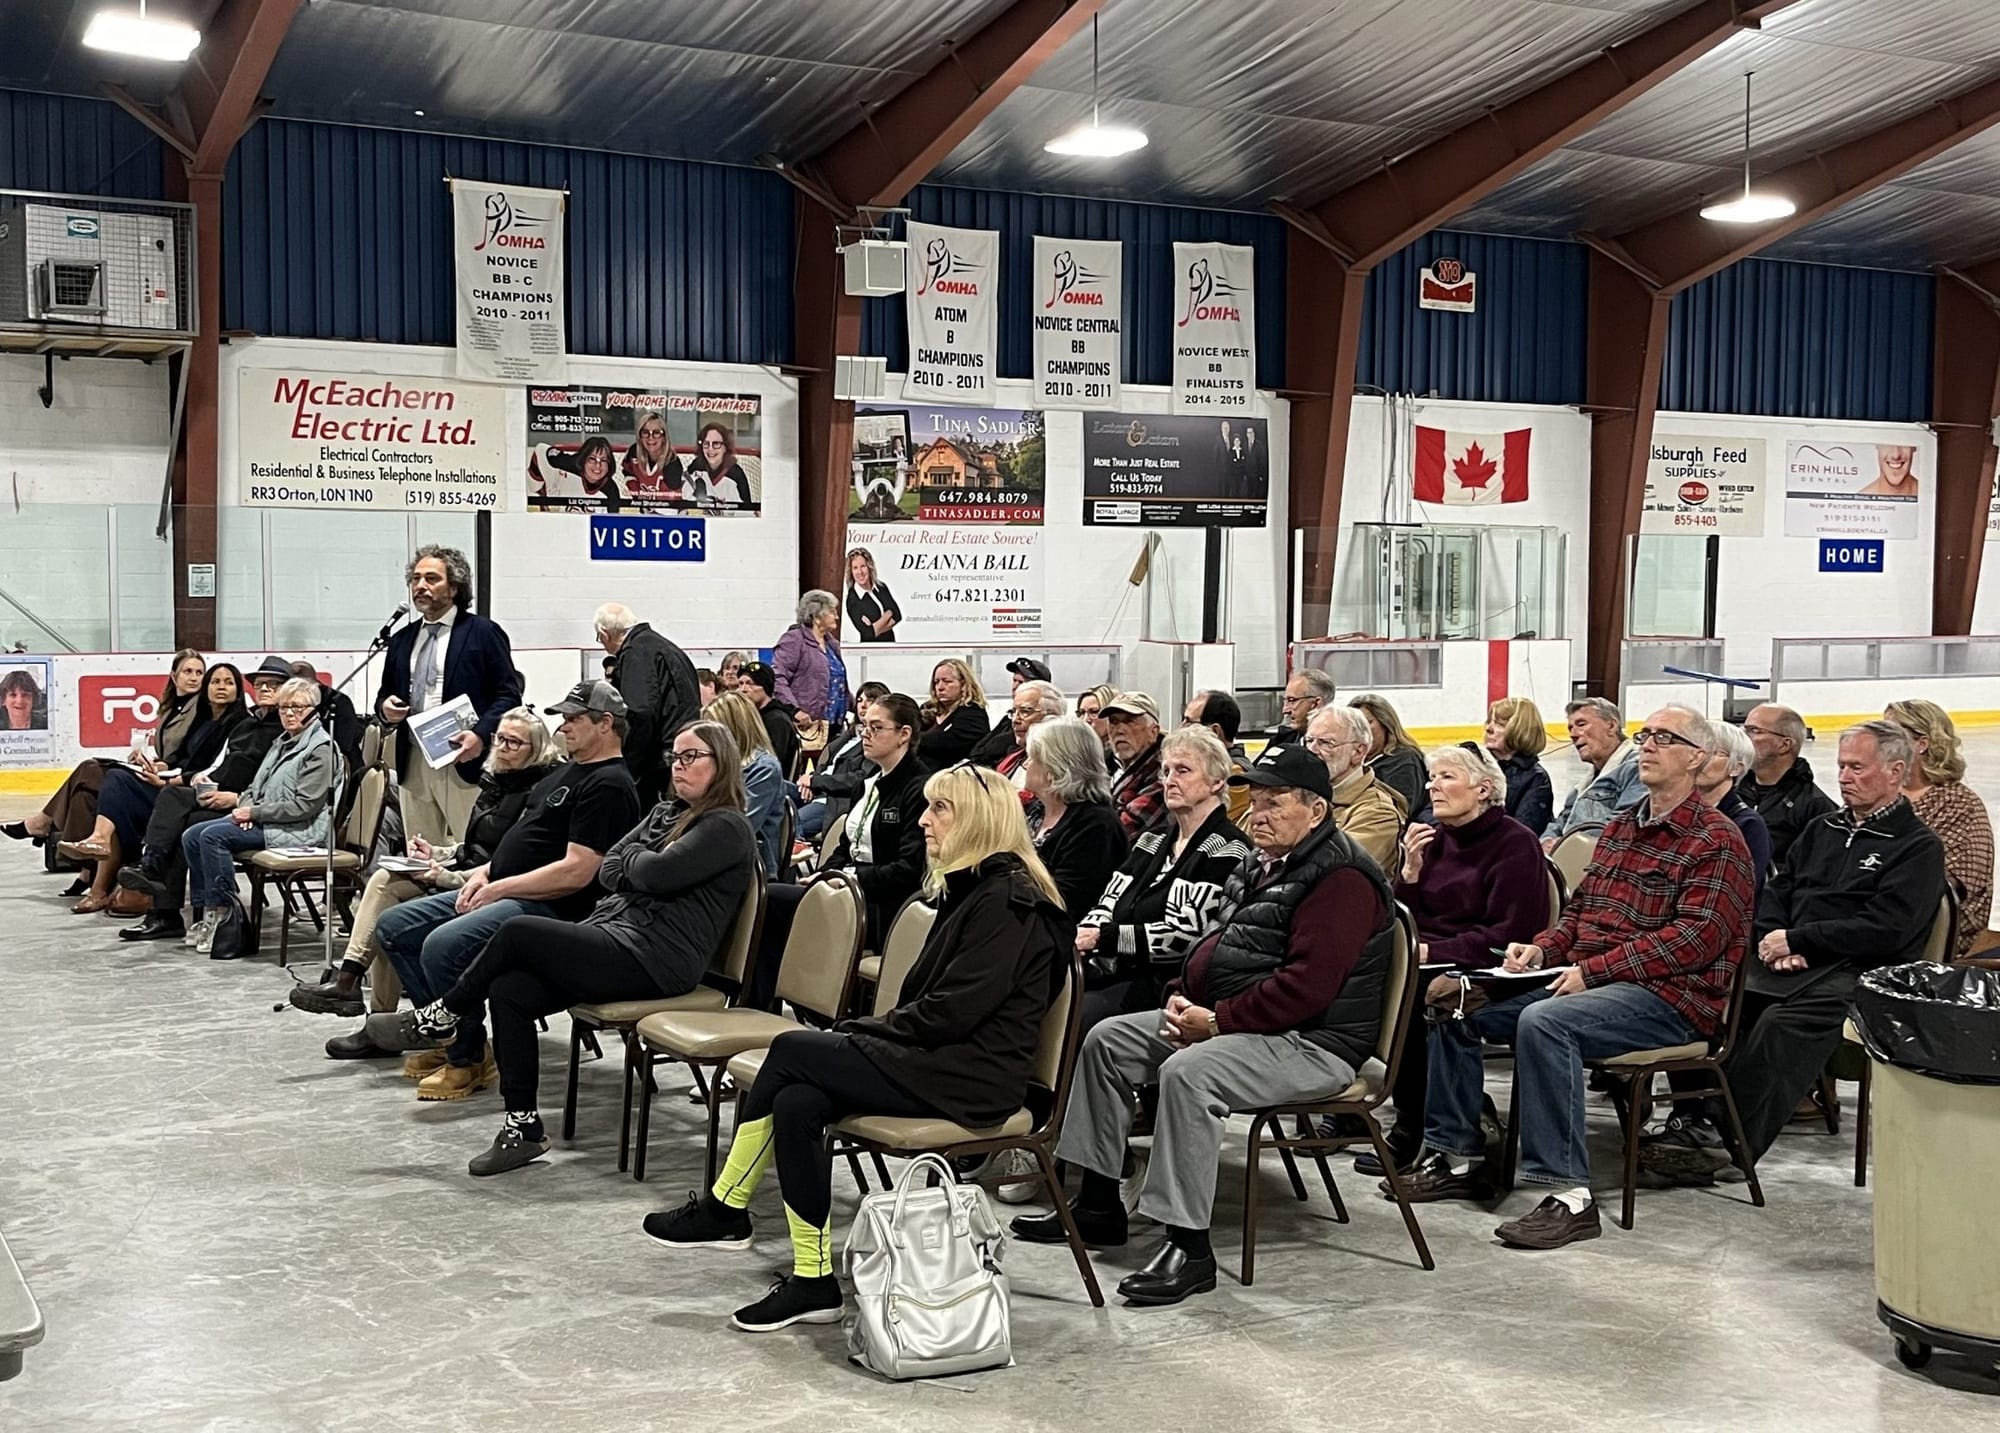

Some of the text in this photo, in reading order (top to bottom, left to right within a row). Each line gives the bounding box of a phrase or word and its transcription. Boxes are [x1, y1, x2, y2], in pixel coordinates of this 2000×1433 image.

[496, 235, 546, 249] OMHA
[486, 256, 538, 269] NOVICE
[492, 273, 511, 284] BB
[523, 276, 533, 286] C
[936, 280, 978, 296] OMHA
[472, 289, 553, 303] CHAMPIONS
[1063, 292, 1104, 306] OMHA
[476, 306, 508, 319] 2010
[520, 310, 551, 321] 2011
[934, 306, 967, 323] ATOM
[1196, 306, 1241, 322] OMHA
[1035, 316, 1121, 334] NOVICE CENTRAL
[946, 330, 954, 344] B
[1071, 340, 1085, 354] BB
[1178, 347, 1250, 358] NOVICE WEST
[917, 349, 984, 368] CHAMPIONS
[1047, 360, 1110, 377] CHAMPIONS
[1208, 363, 1222, 373] BB
[913, 370, 944, 387] 2010
[956, 375, 985, 389] 2011
[1186, 378, 1244, 389] FINALISTS
[273, 377, 455, 411] McEachern
[1045, 382, 1073, 397] 2010
[1085, 383, 1112, 398] 2011
[606, 393, 758, 414] YOUR HOME TEAM ADVANTAGE!
[1184, 395, 1210, 404] 2014
[1220, 395, 1246, 406] 2015
[291, 411, 477, 446] Electric Ltd.
[930, 414, 1037, 435] TINA SADLER
[320, 446, 433, 464] Electrical Contractors
[1652, 445, 1747, 467] lsburgh Feed
[251, 463, 497, 485] Residential & Business Telephone Installations
[1664, 467, 1717, 479] SUPPLIES
[1790, 464, 1858, 476] ERIN HILLS
[1801, 476, 1847, 484] DENTAL
[251, 487, 276, 500] RR3
[278, 487, 319, 503] Orton,
[1109, 483, 1163, 493] 519-833-9714
[405, 490, 497, 506] (519) 855-4269
[939, 490, 1028, 505] 647.984.8079
[924, 508, 1041, 520] TINASADLER.COM
[1674, 515, 1717, 526] 855-4403
[593, 527, 702, 549] VISITOR
[848, 529, 1038, 545] Your Local Real Estate Source!
[900, 554, 1030, 571] DEANNA BALL
[1826, 548, 1878, 564] HOME
[928, 573, 949, 582] Sales
[935, 589, 1026, 602] 647.821.2301
